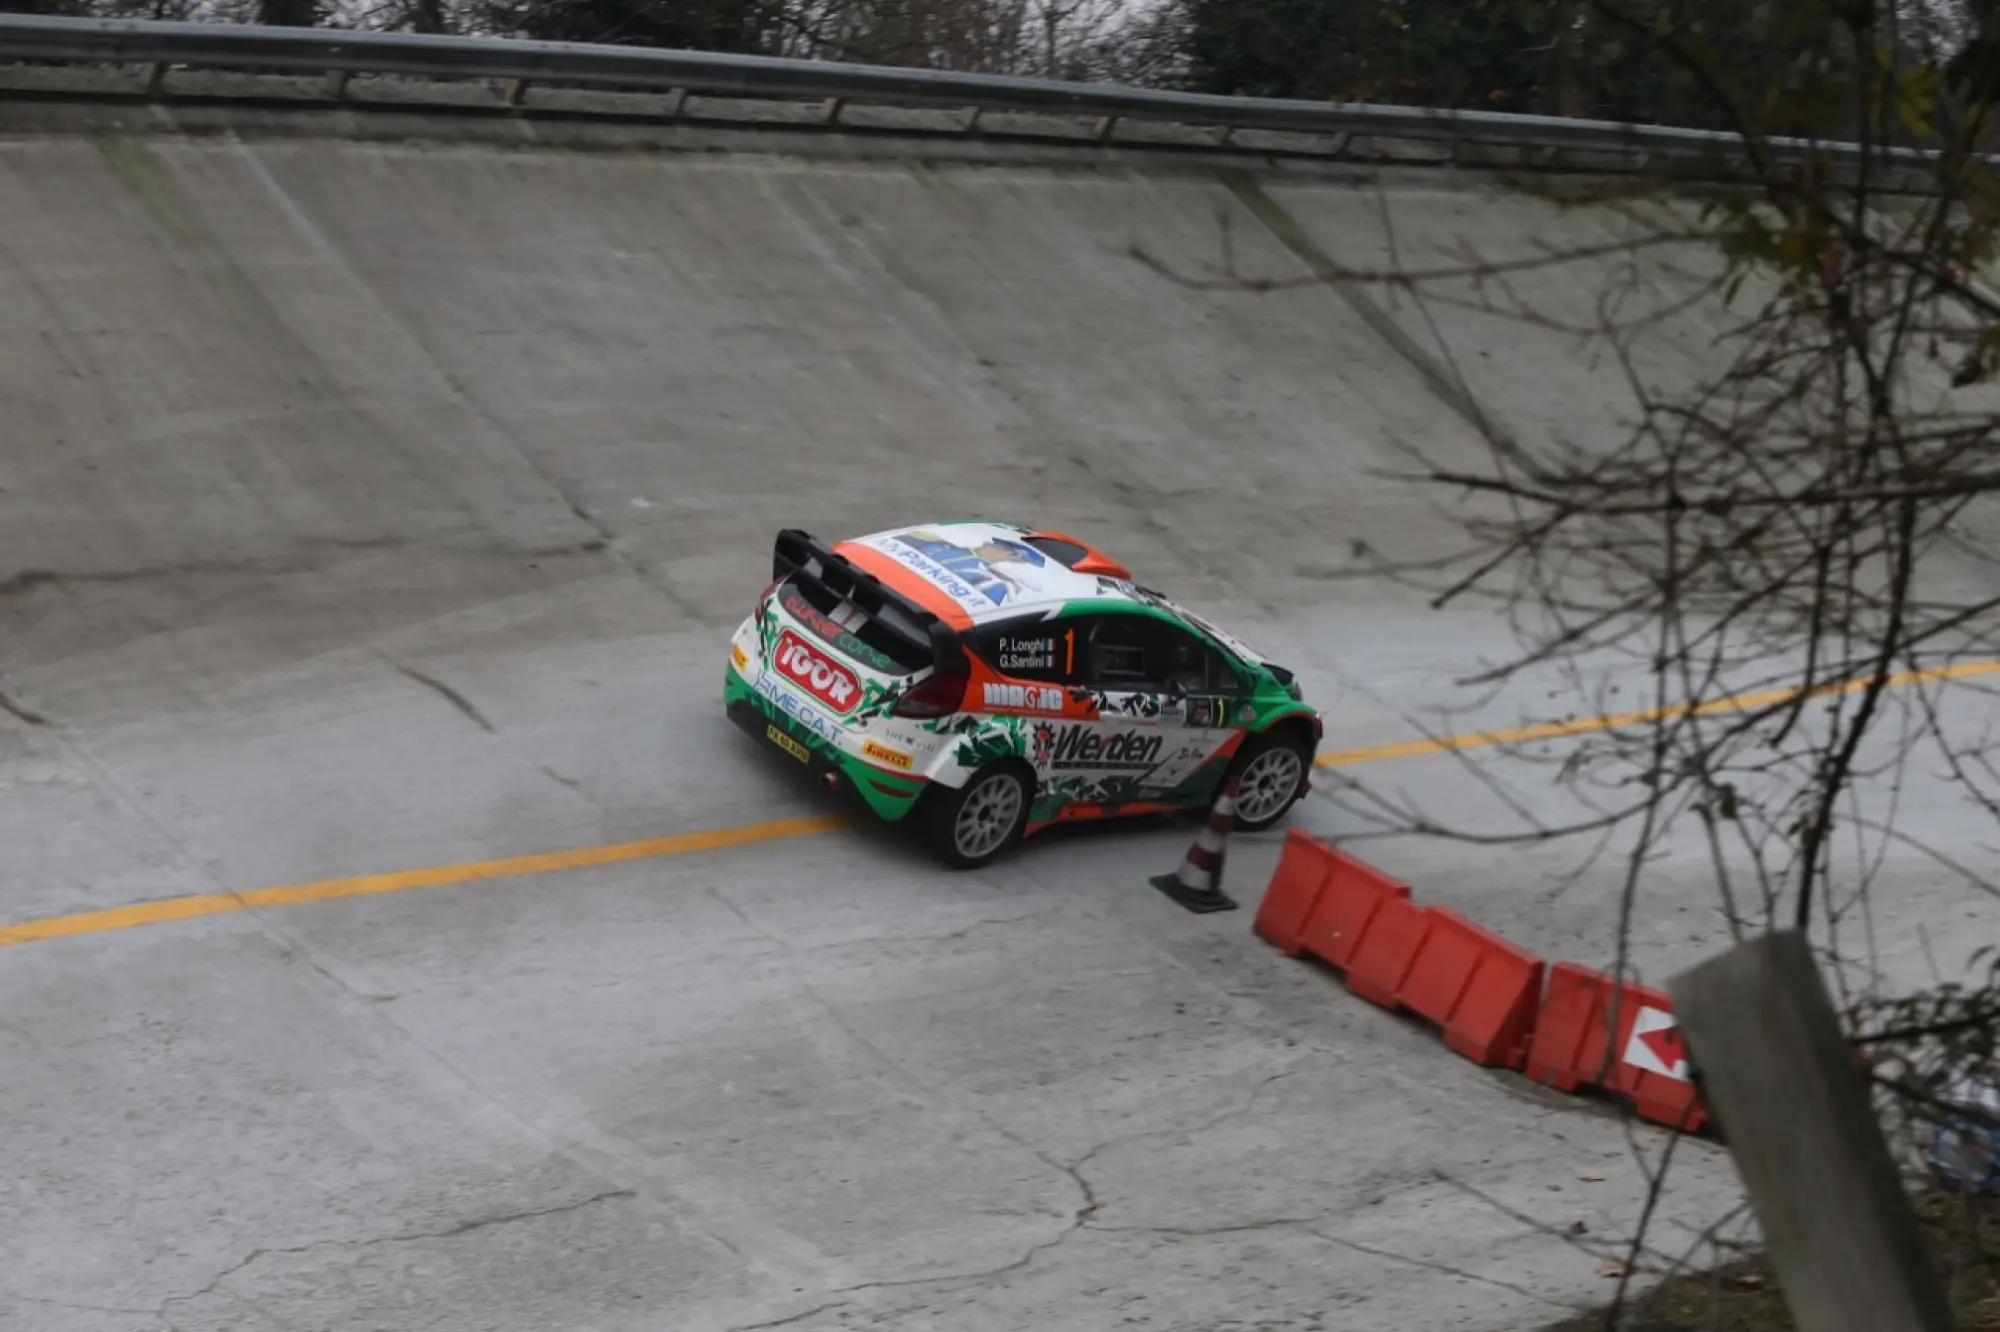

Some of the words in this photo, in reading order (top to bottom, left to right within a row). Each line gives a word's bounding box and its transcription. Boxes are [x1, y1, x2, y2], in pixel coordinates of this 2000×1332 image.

[1000, 638, 1009, 652] P.
[1012, 637, 1044, 655] Longhi
[1064, 628, 1074, 675] 1
[1053, 725, 1163, 762] Werden
